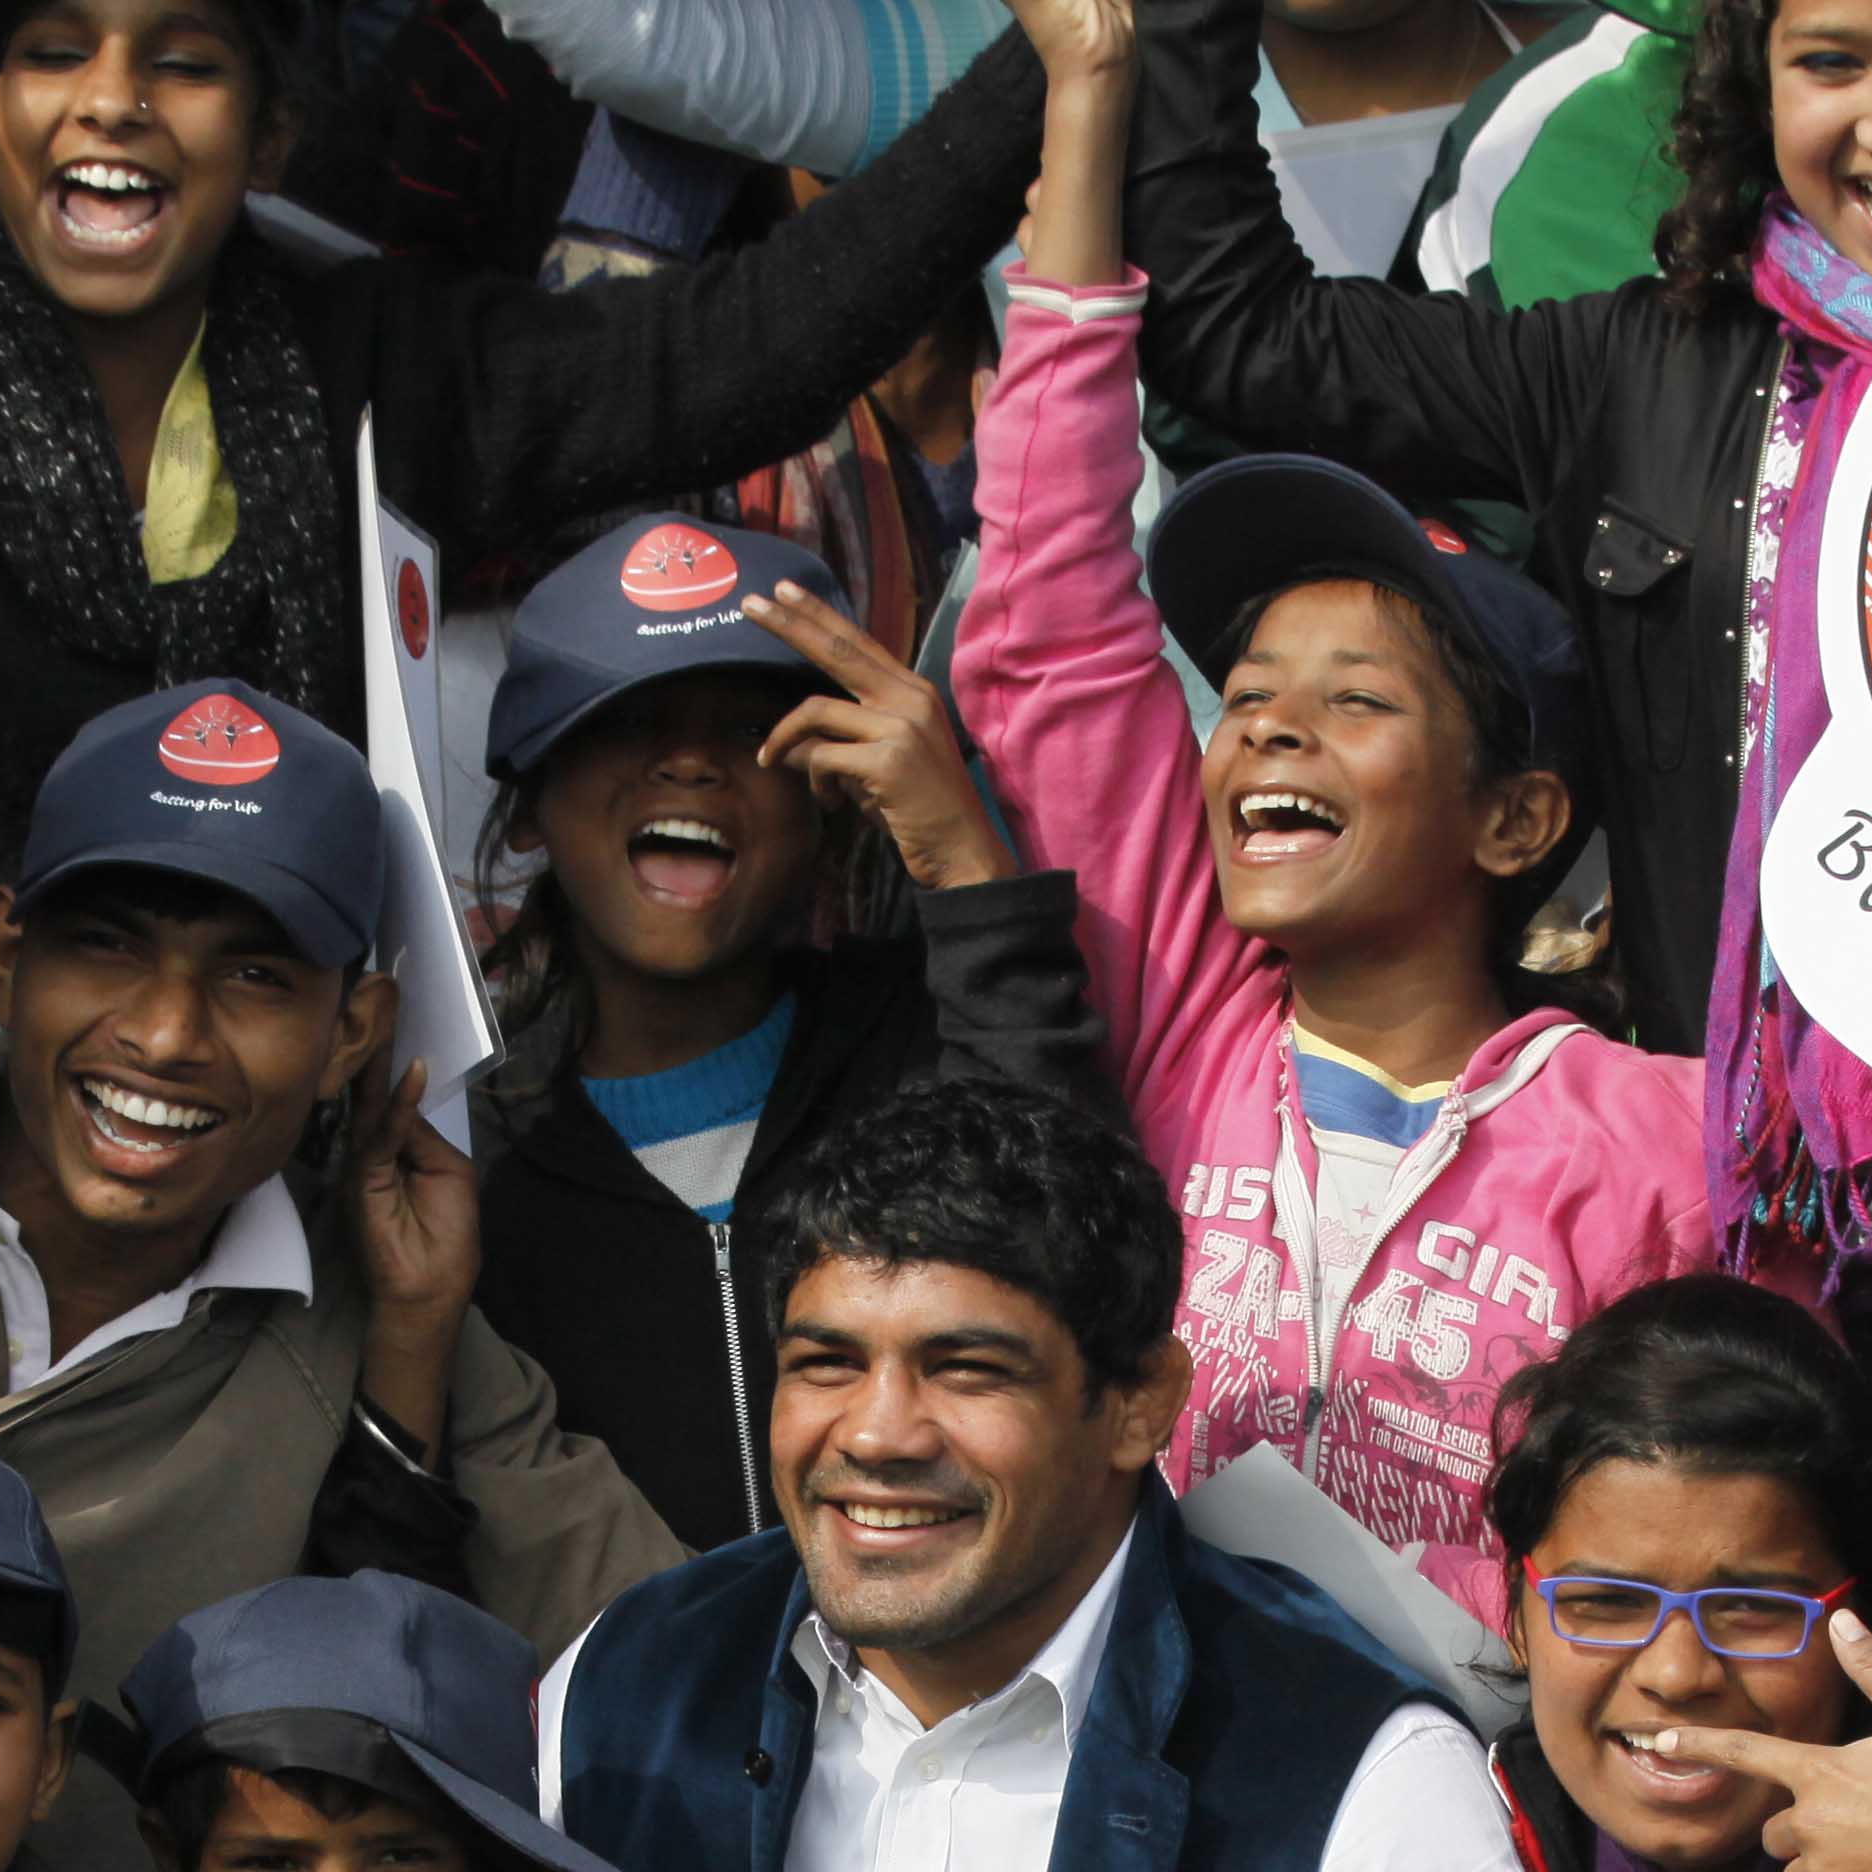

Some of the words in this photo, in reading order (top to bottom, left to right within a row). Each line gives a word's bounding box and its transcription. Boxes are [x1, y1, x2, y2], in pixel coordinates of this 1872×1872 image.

[694, 616, 717, 631] for
[717, 609, 744, 624] life
[208, 798, 232, 812] for
[234, 800, 263, 815] life
[1351, 1268, 1479, 1380] 45
[1367, 1396, 1441, 1440] FORMATION
[1442, 1421, 1491, 1458] SERIES
[1369, 1426, 1391, 1449] FOR
[1393, 1433, 1434, 1466] DENIM
